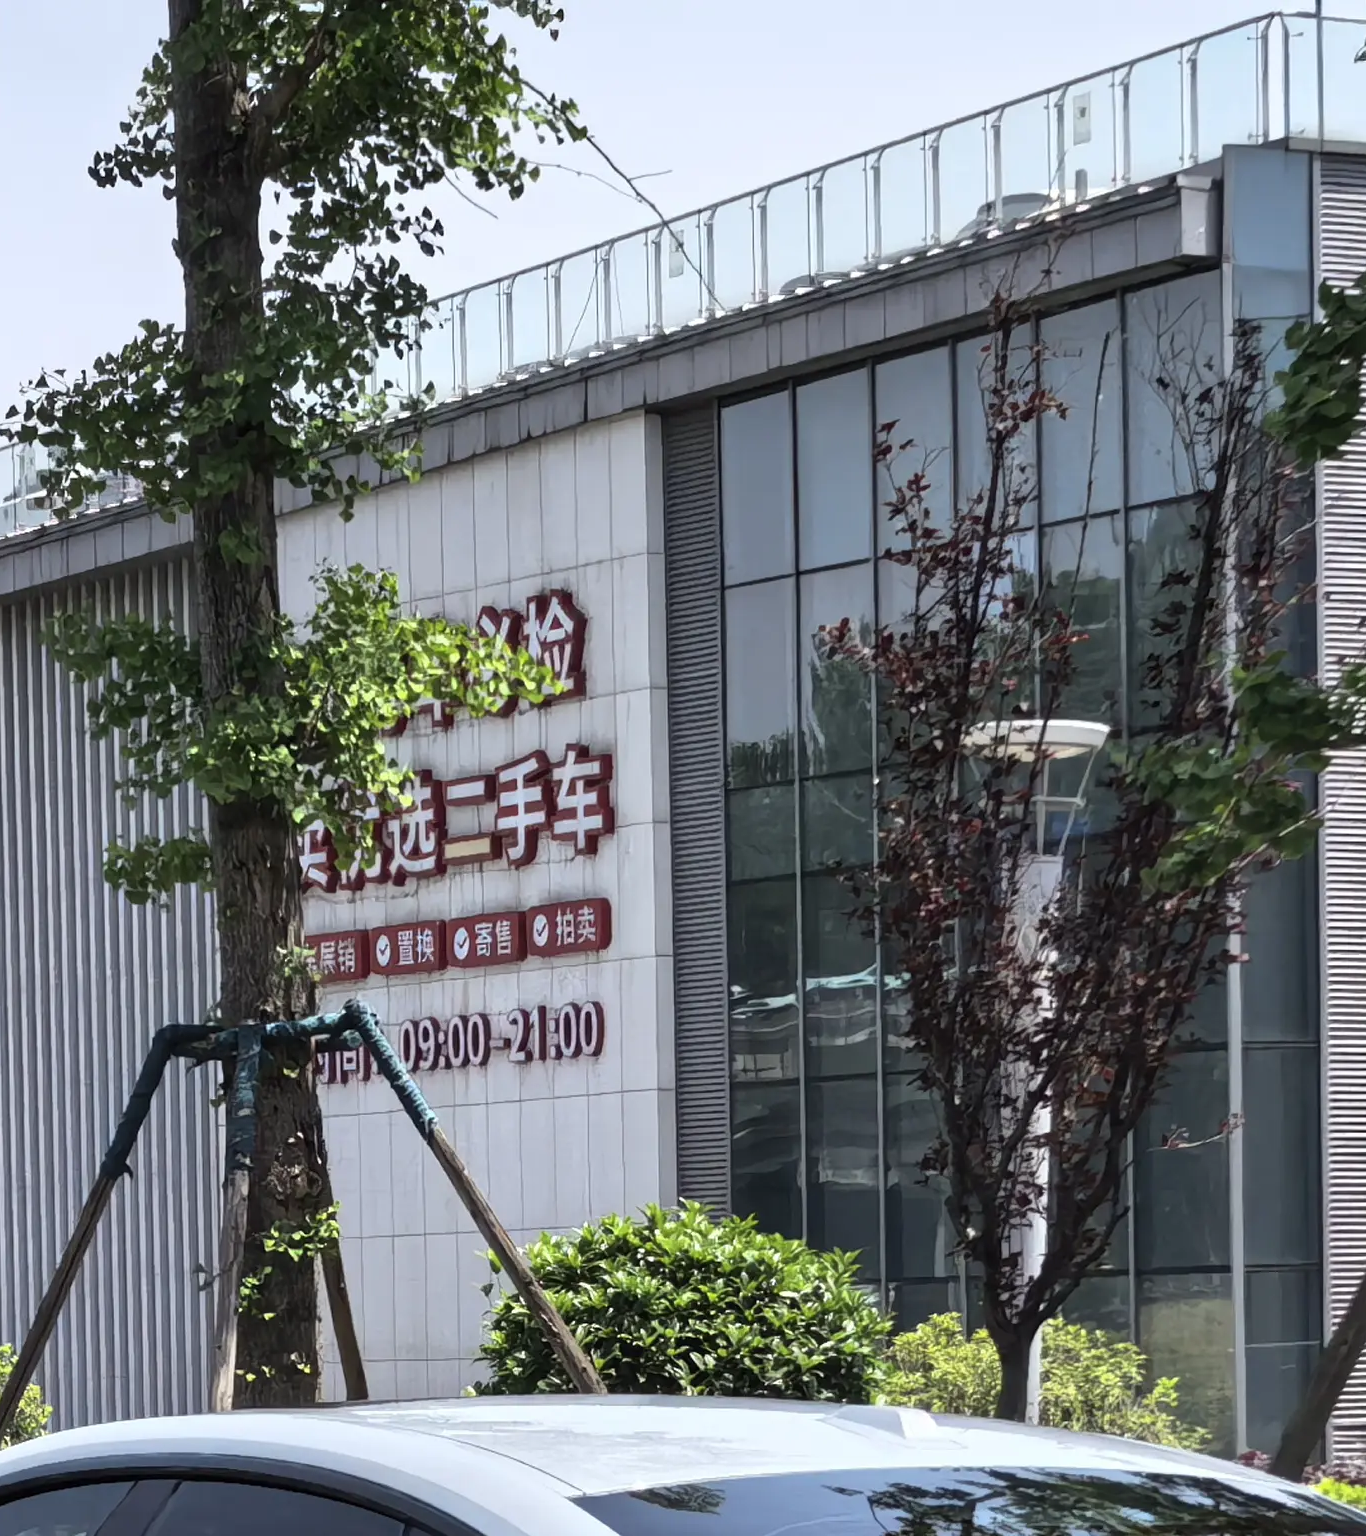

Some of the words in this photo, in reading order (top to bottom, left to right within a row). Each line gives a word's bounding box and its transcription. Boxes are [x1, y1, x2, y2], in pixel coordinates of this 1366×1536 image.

[396, 927, 435, 967] 置换
[474, 919, 512, 957] 寄售
[555, 904, 597, 947] 拍卖
